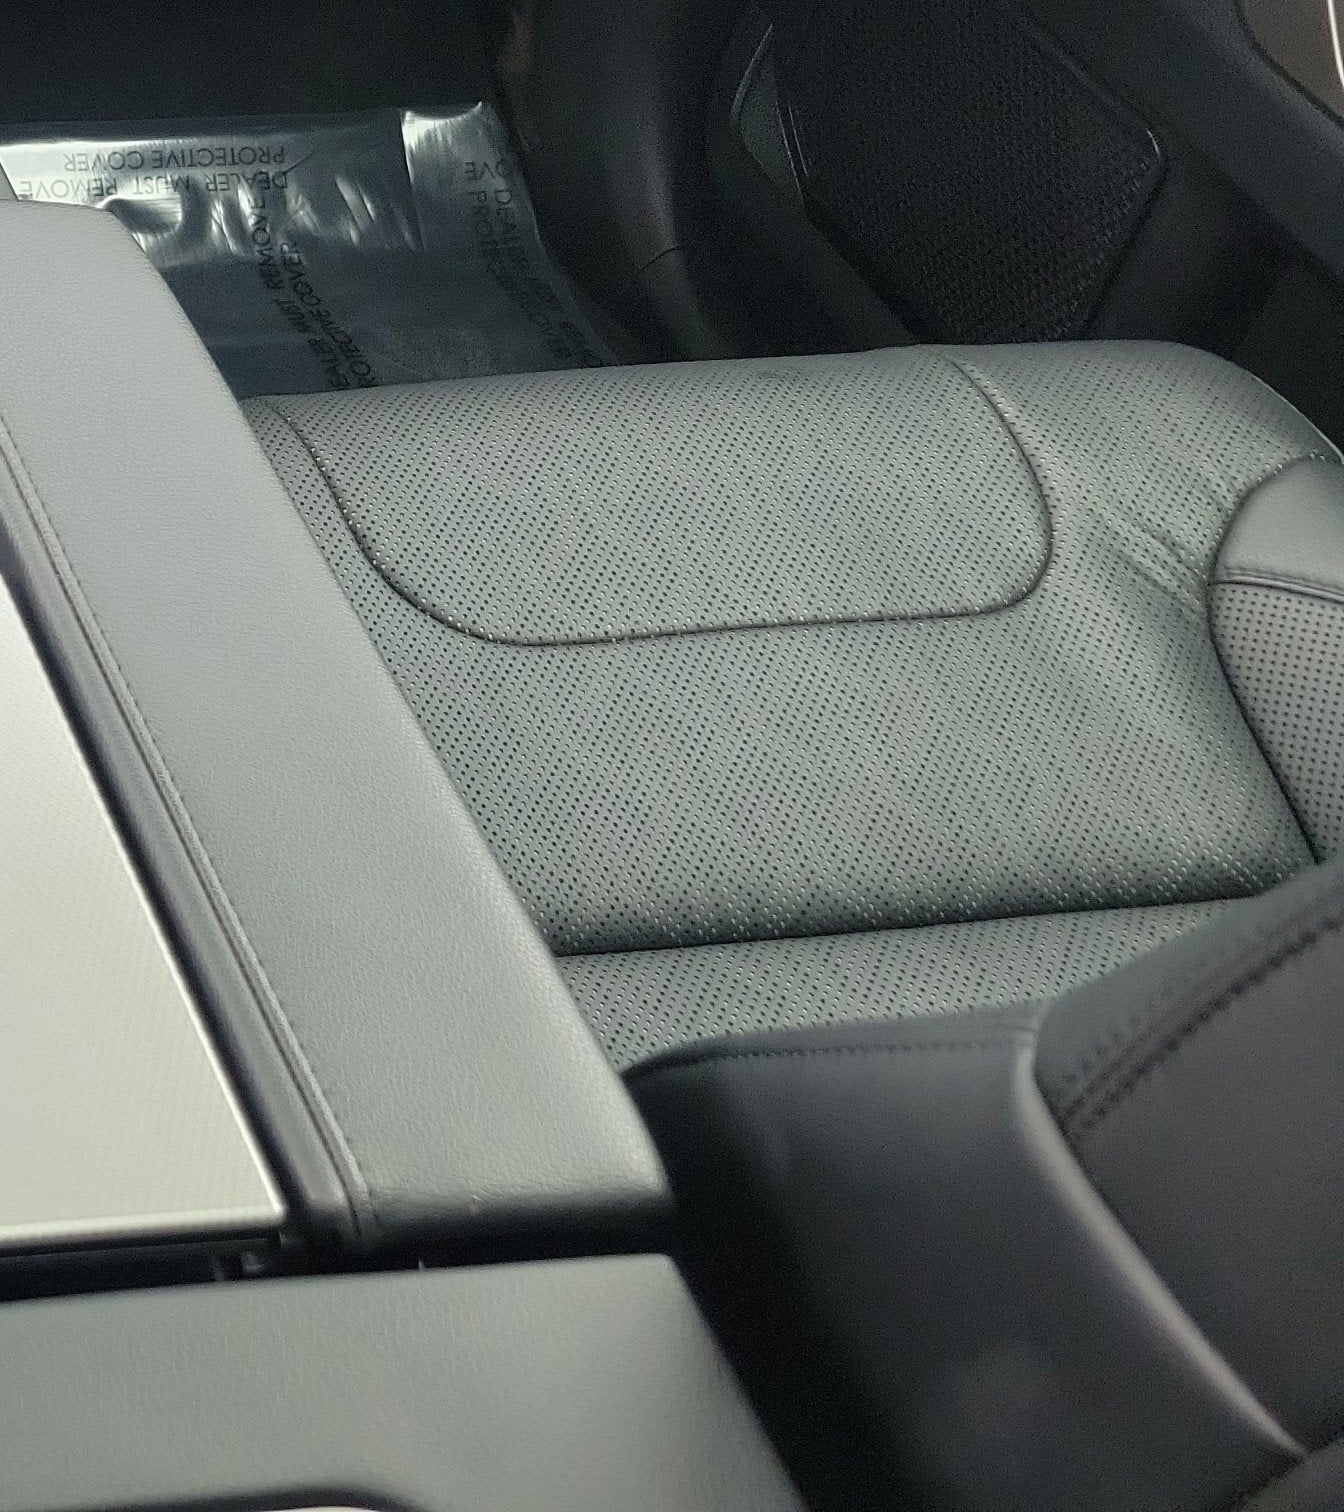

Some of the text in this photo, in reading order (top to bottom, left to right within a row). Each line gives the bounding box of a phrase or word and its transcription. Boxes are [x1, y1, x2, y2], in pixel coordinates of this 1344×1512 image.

[64, 146, 286, 173] PROTECTIVE COVER
[19, 170, 289, 200] DEALER MUST REMOVE
